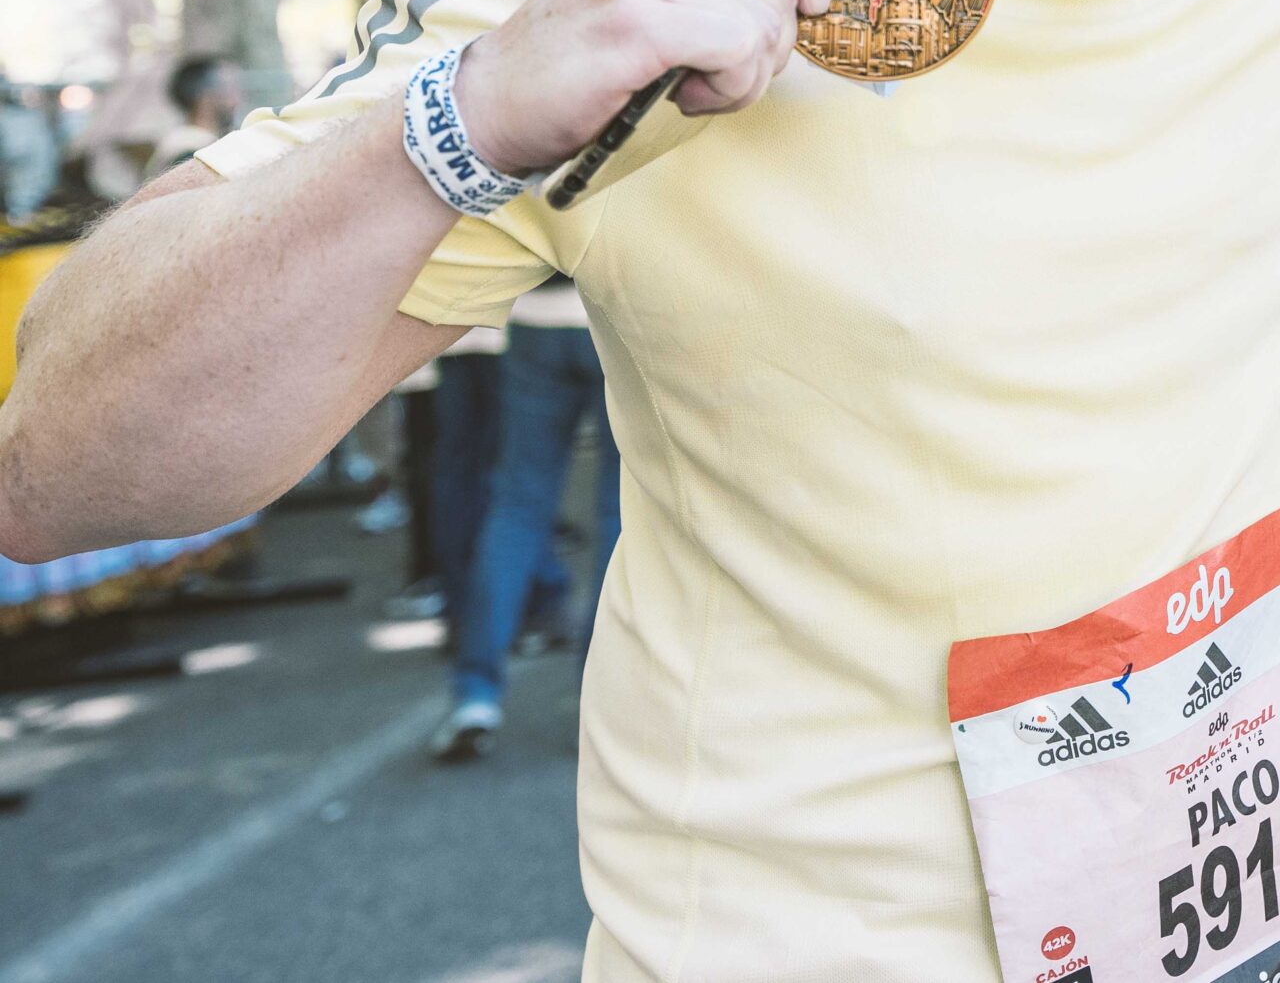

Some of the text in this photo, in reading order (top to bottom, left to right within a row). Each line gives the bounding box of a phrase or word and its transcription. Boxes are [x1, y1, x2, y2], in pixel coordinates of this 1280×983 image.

[1166, 564, 1234, 635] edp
[1182, 665, 1243, 719] adidas
[1023, 724, 1055, 734] RUNNING
[1208, 712, 1229, 736] edp
[1037, 730, 1131, 767] adidas
[1186, 748, 1233, 785] MARATHON
[1187, 738, 1265, 794] MADRID
[1187, 759, 1280, 848] PACO
[1043, 933, 1072, 952] 42K
[1036, 955, 1089, 983] CAJÓN
